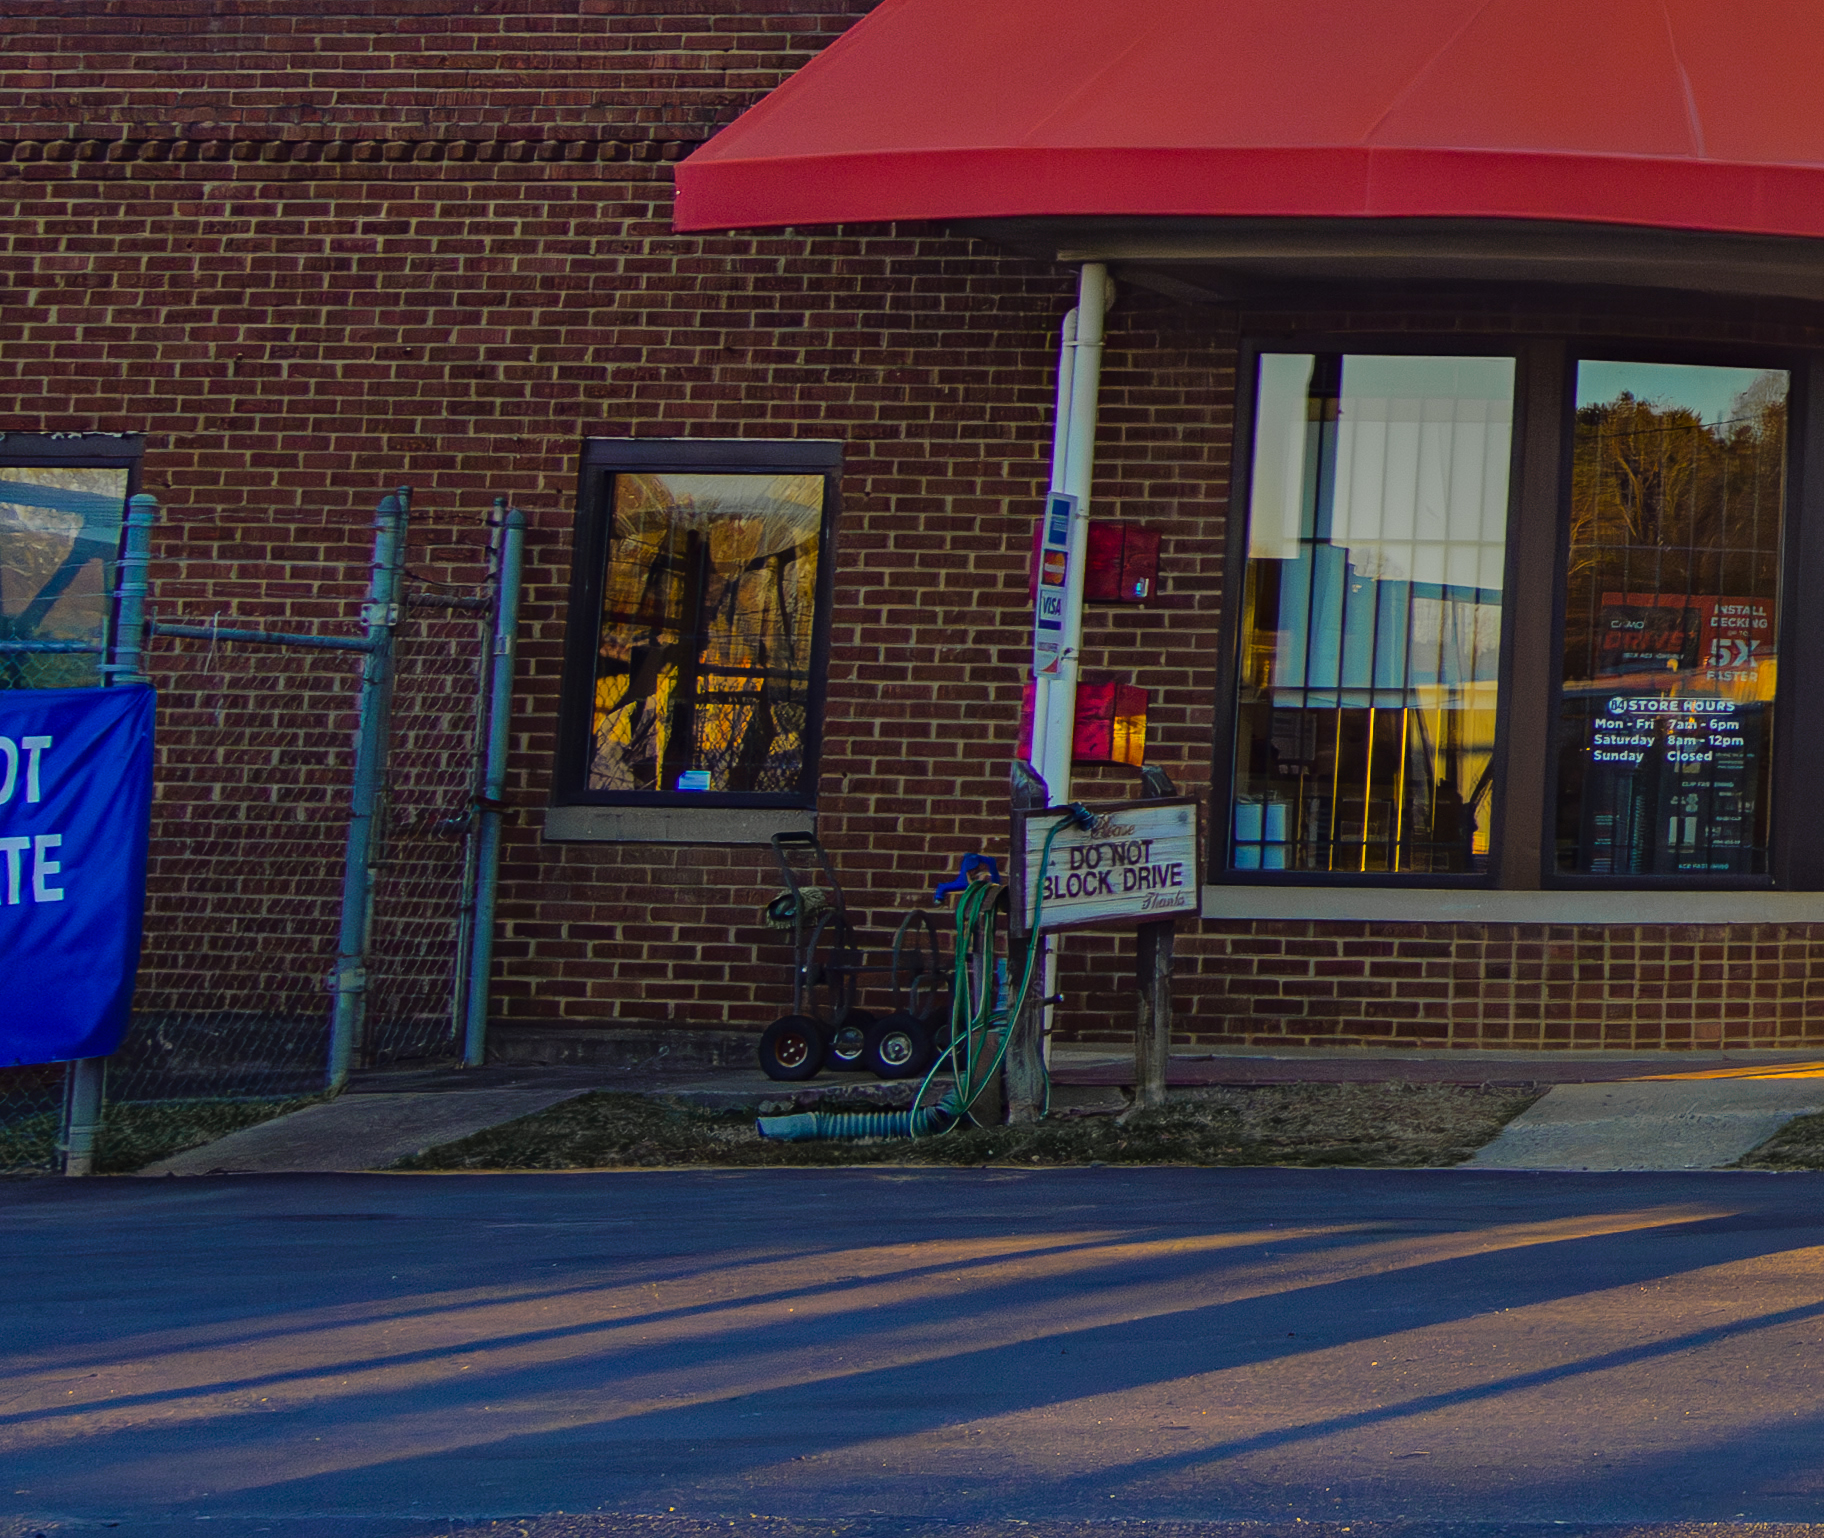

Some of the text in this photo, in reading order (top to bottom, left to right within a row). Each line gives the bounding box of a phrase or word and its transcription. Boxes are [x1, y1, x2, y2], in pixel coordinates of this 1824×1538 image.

[1043, 596, 1062, 616] VISA
[1710, 616, 1768, 629] DECKING
[1708, 638, 1761, 668] 5X
[1628, 700, 1679, 711] STORE
[1684, 700, 1736, 712] HOURS
[1594, 718, 1624, 730] Mon
[1636, 718, 1655, 730] Fri
[1669, 718, 1698, 730] 7am
[1709, 718, 1740, 733] 6pm
[1593, 734, 1656, 748] Saturday
[1667, 734, 1697, 746] 8am
[1709, 734, 1745, 748] 12pm
[1592, 749, 1714, 764] Sunday Closed
[1070, 839, 1154, 871] DO NOT
[0, 833, 65, 907] TE
[1043, 862, 1183, 902] BLOCK DRIVE
[1142, 889, 1187, 911] Thanks
